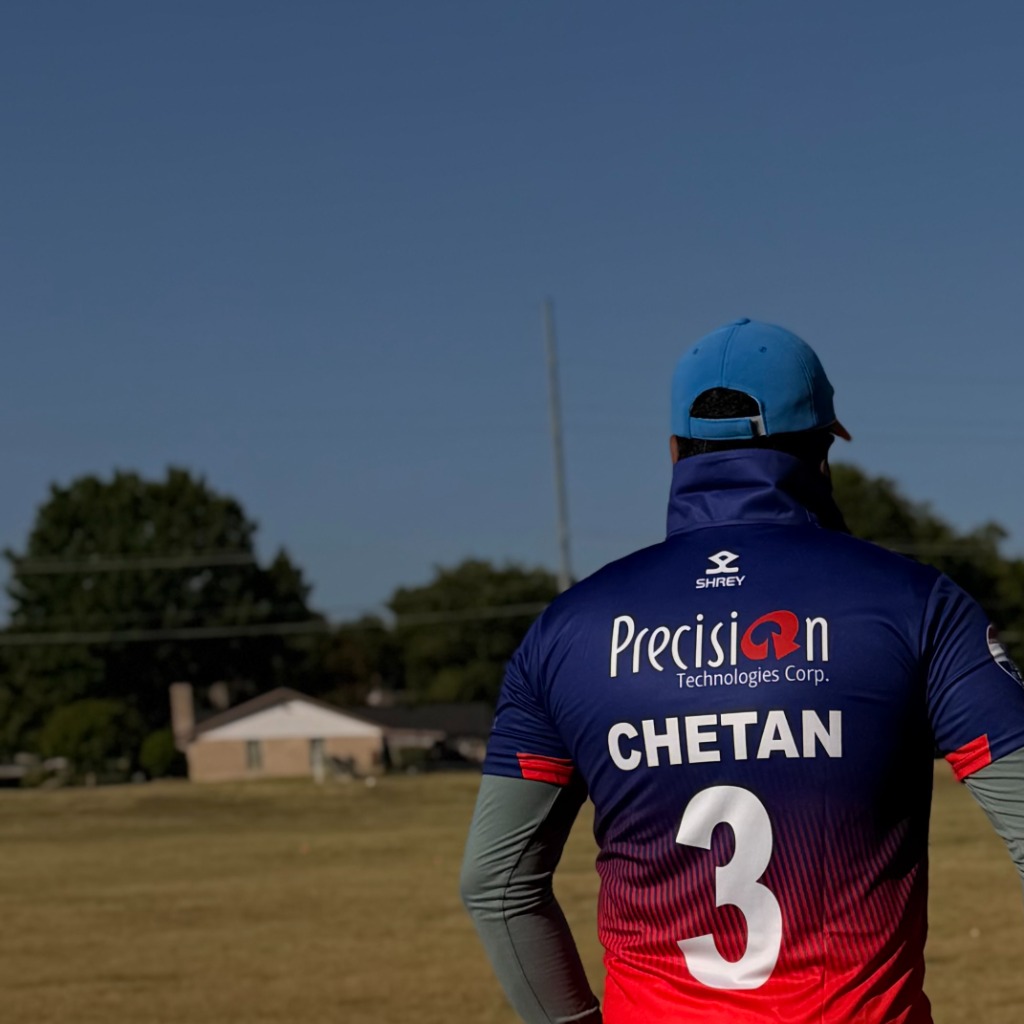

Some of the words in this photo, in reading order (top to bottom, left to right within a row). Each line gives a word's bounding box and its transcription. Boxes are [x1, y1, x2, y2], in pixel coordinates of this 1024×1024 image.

[695, 575, 746, 589] SHREY
[676, 668, 780, 688] Technologies
[784, 665, 830, 687] Corp.
[607, 709, 843, 771] CHETAN
[675, 785, 783, 990] 3
